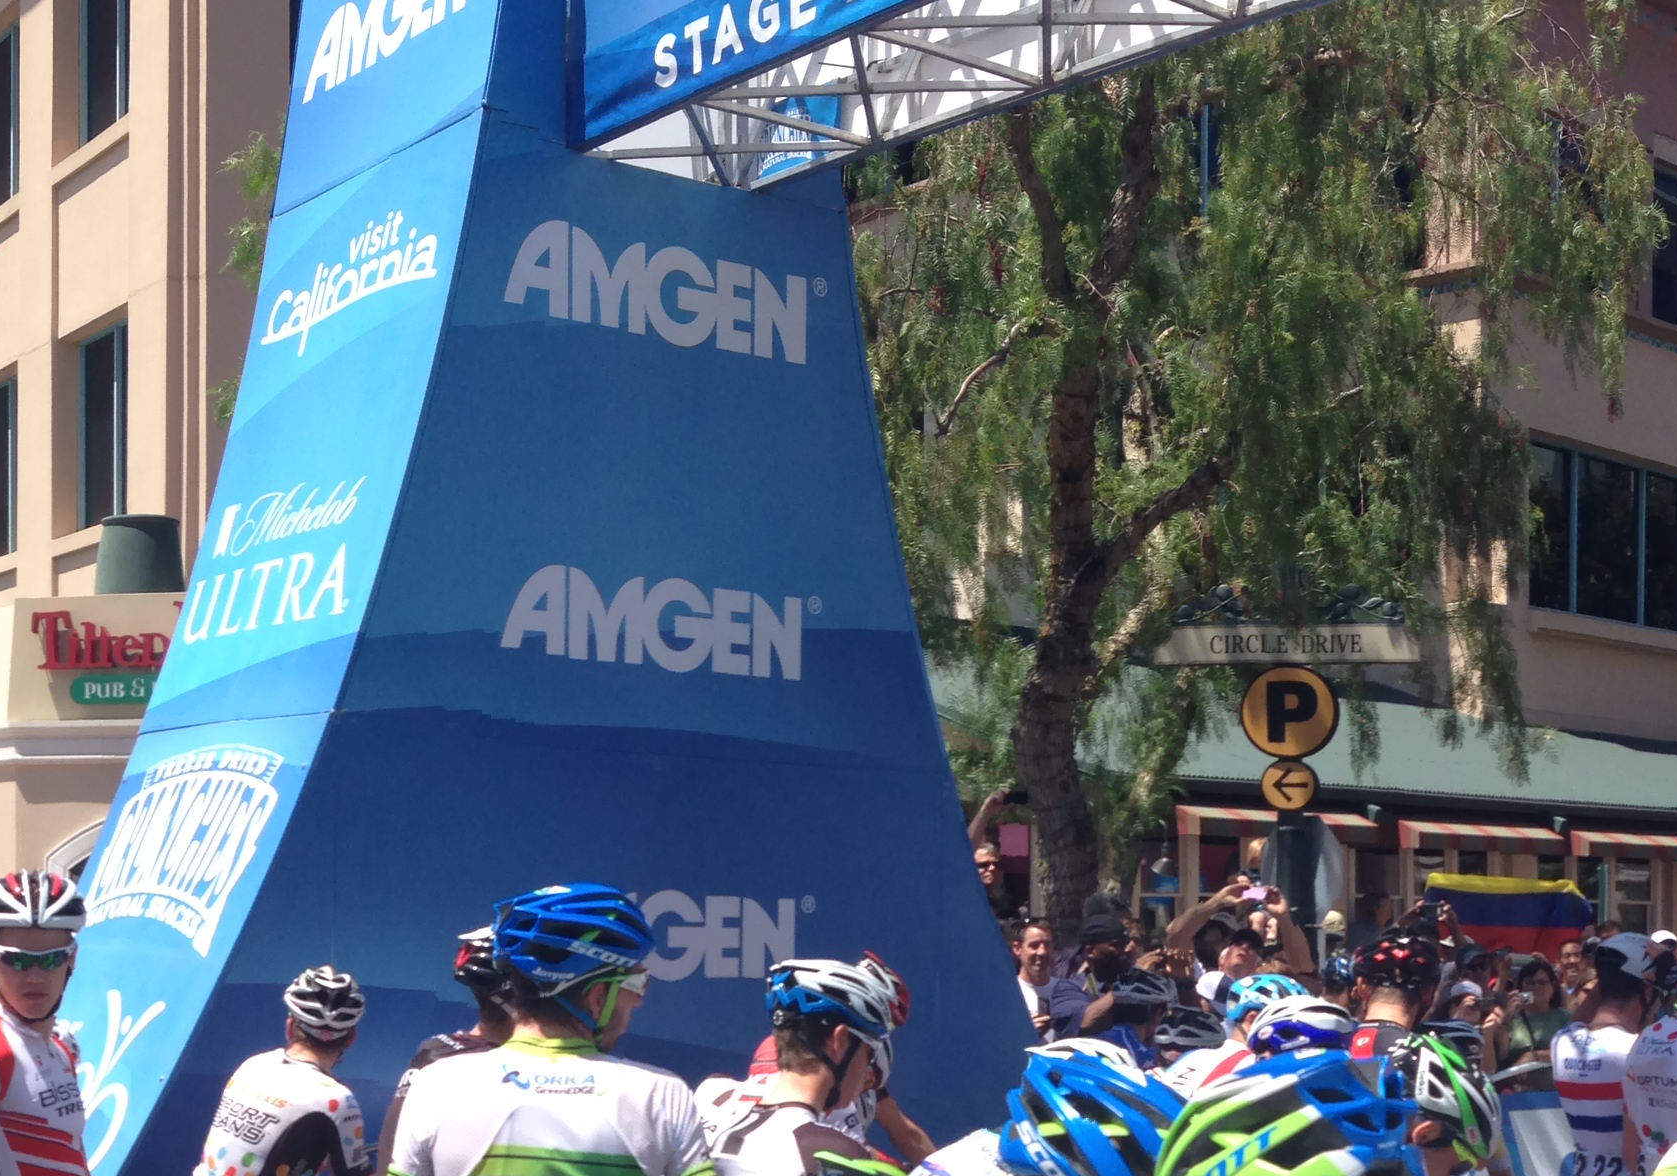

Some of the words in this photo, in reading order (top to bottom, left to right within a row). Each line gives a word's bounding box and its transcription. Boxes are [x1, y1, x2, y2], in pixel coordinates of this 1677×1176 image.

[654, 0, 818, 88] STAGE
[349, 210, 404, 264] visit
[261, 225, 438, 356] California
[504, 219, 807, 364] AMGEN
[233, 475, 368, 557] Michelob
[183, 541, 348, 645] ULTRA
[500, 564, 802, 681] AMGEN
[1209, 632, 1296, 657] CIRCLE
[1302, 630, 1363, 655] DRIVE
[84, 682, 125, 699] PUB
[1265, 679, 1318, 744] P
[568, 939, 637, 968] SCOTT
